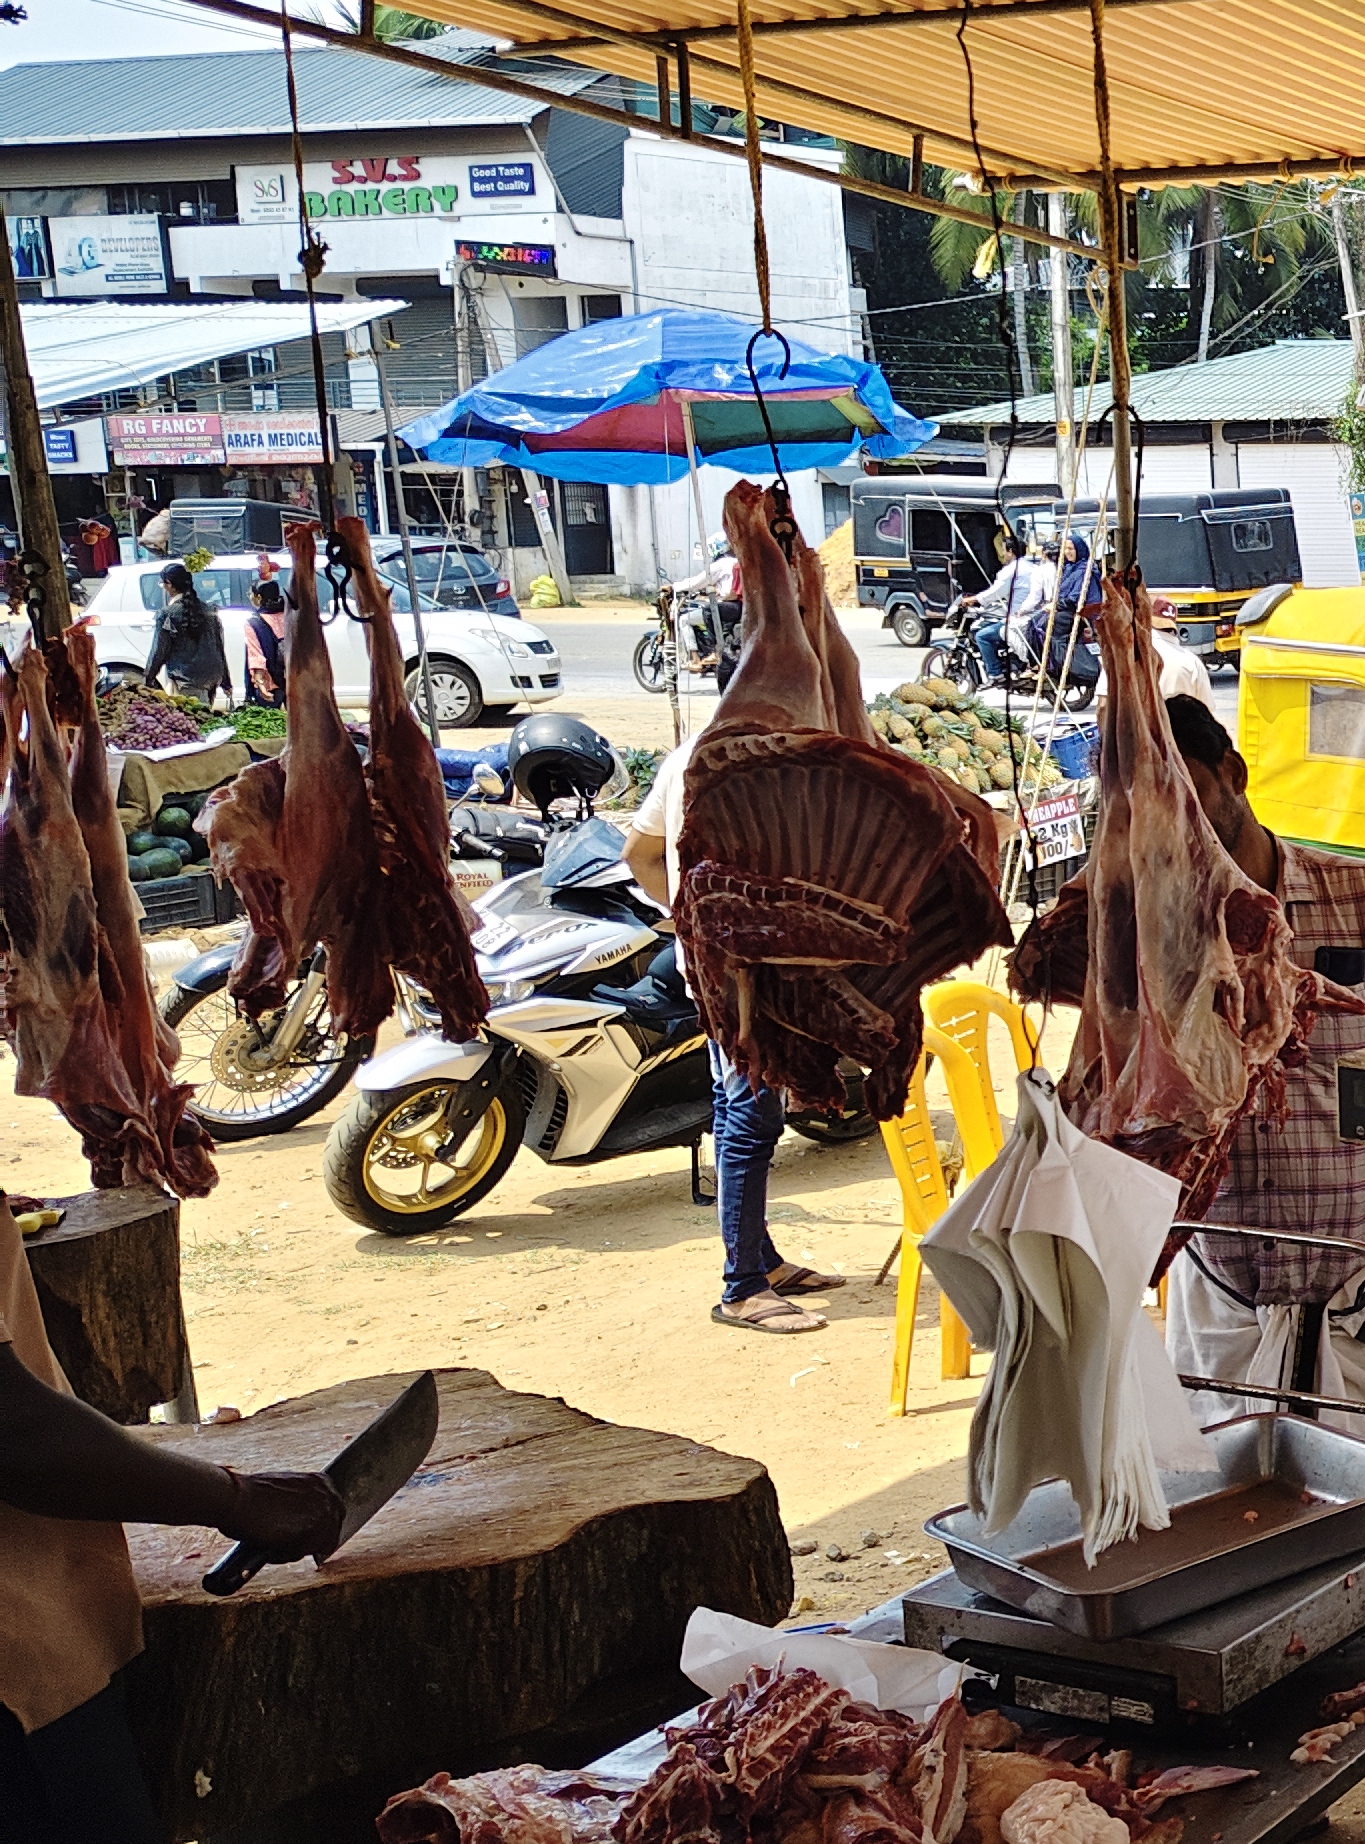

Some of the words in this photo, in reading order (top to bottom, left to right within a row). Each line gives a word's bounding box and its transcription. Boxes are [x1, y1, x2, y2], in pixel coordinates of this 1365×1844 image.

[331, 156, 421, 184] S.V.S
[472, 167, 496, 177] Good
[498, 166, 525, 176] Taste
[473, 182, 495, 192] Best
[497, 180, 530, 192] Quality
[303, 184, 458, 217] BAKERY
[123, 419, 146, 435] RG
[152, 418, 207, 434] FANCY
[227, 432, 265, 448] ARAFA
[268, 431, 322, 447] MEDICAL
[1024, 798, 1076, 822] NEAPPLE
[1038, 827, 1048, 840] 2
[1050, 823, 1069, 838] Kg
[456, 872, 489, 881] ROYAL
[594, 943, 633, 964] YAMAHA
